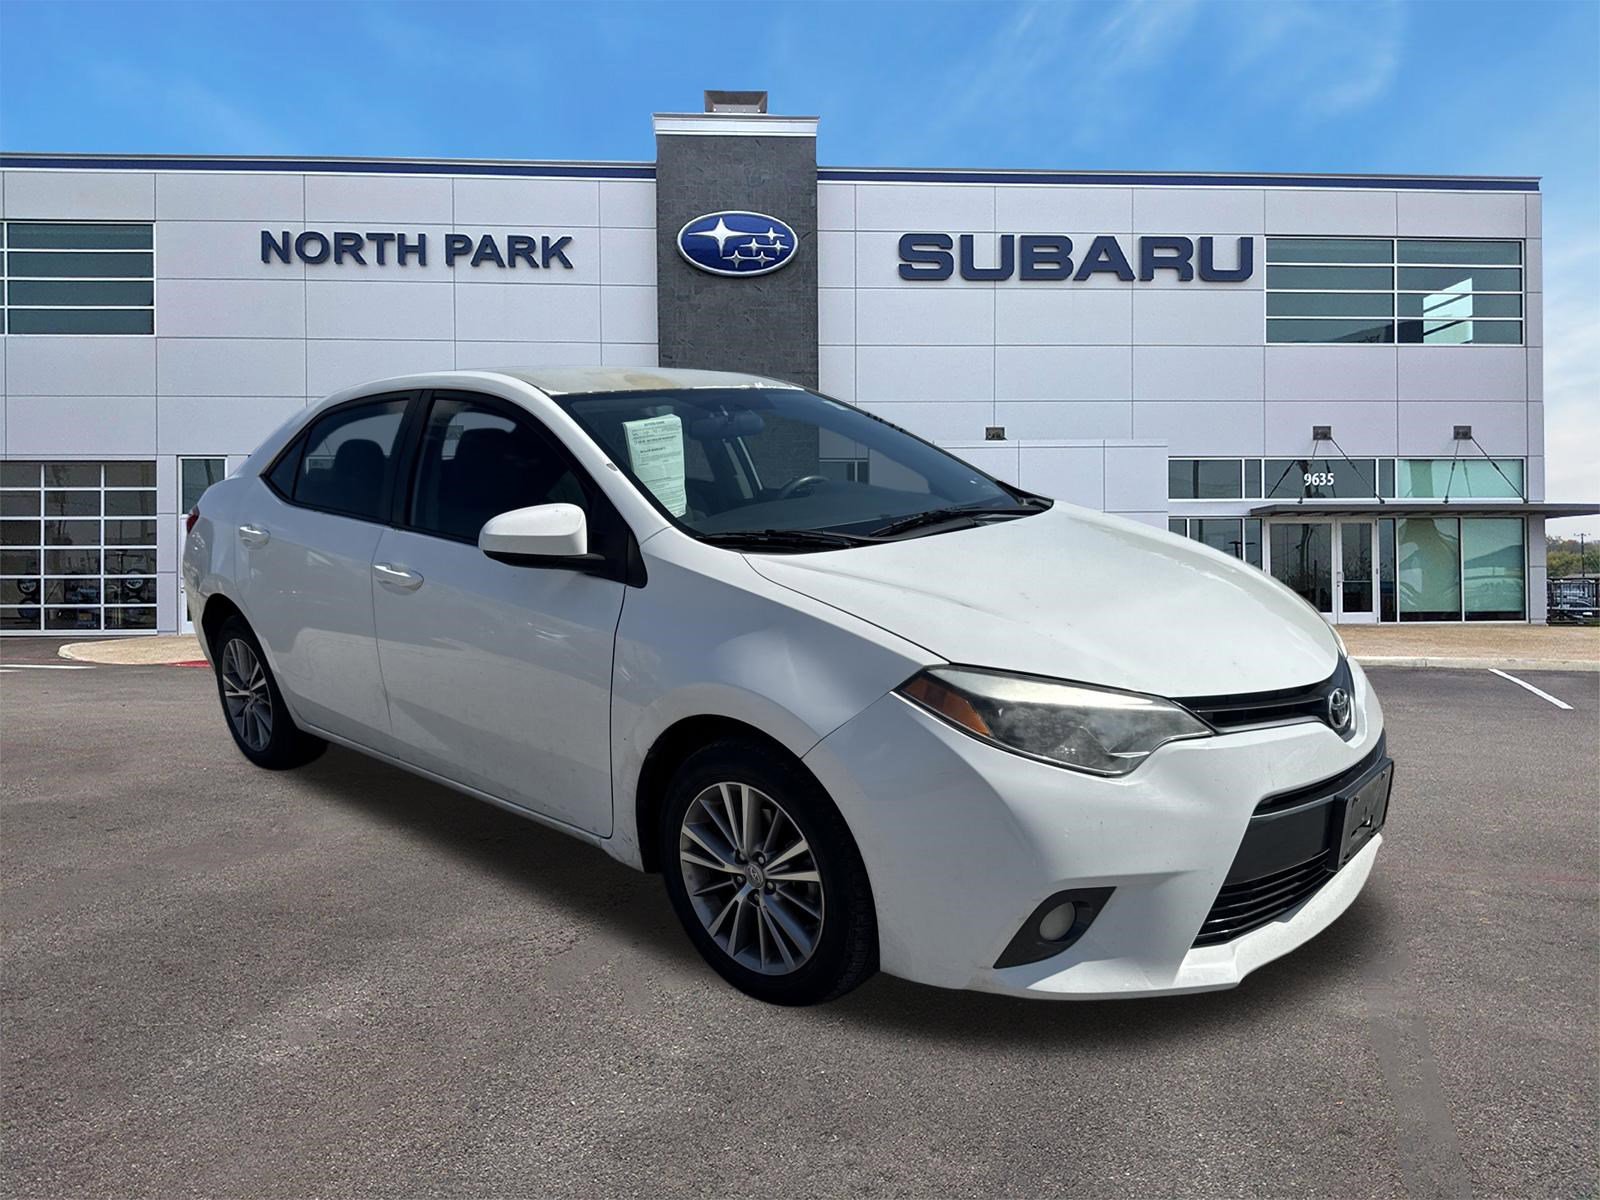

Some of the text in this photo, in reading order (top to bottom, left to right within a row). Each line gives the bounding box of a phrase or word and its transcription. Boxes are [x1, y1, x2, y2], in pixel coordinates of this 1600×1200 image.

[261, 231, 573, 269] NORTH PARK
[898, 233, 1253, 282] SUBARU
[1304, 473, 1334, 486] 9635
